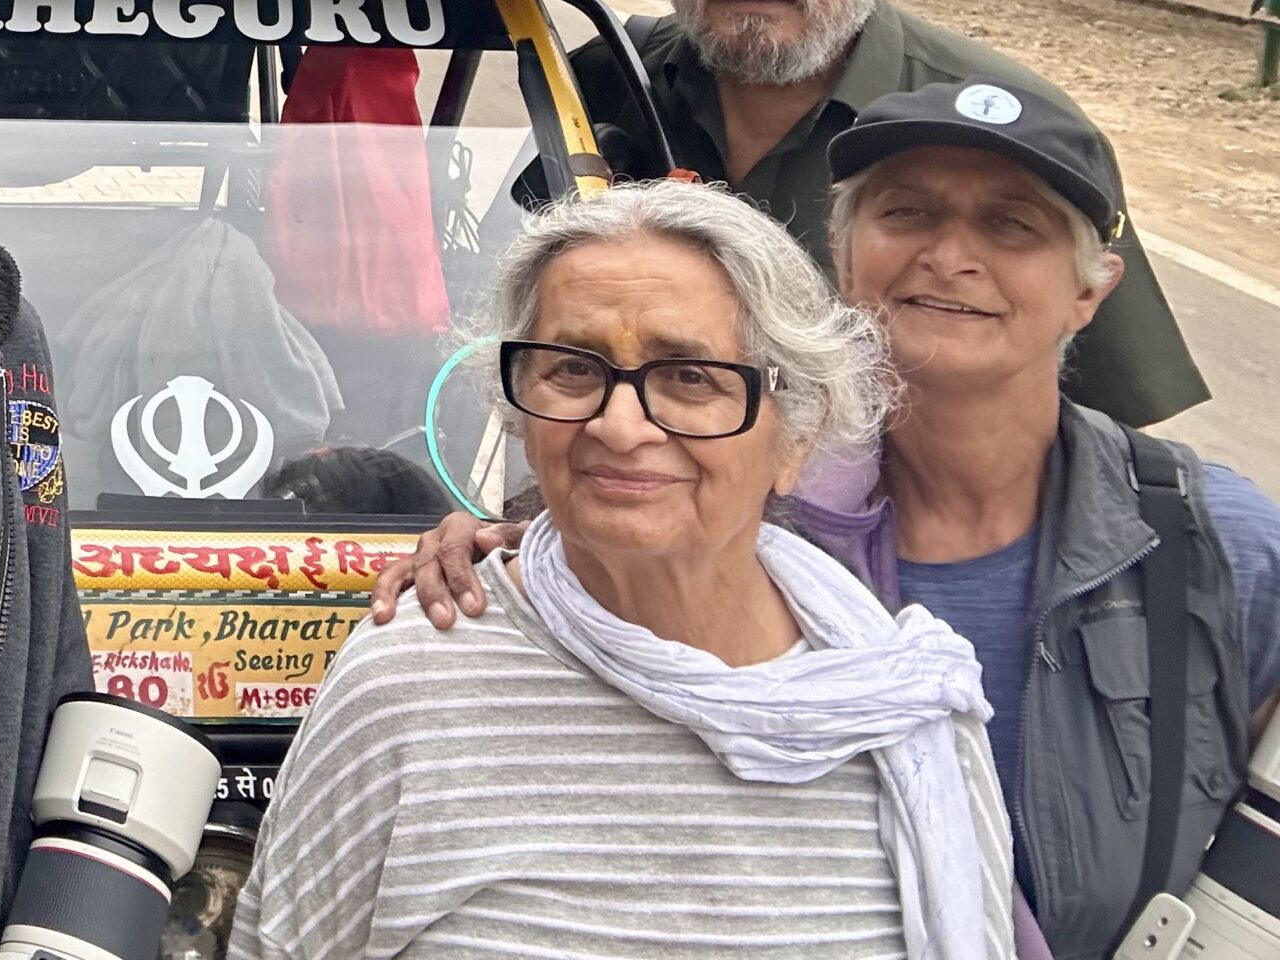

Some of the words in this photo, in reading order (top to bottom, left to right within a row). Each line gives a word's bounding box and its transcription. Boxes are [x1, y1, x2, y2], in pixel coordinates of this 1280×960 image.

[22, 409, 59, 434] BEST
[234, 649, 314, 681] Seeing
[235, 767, 257, 799] से
